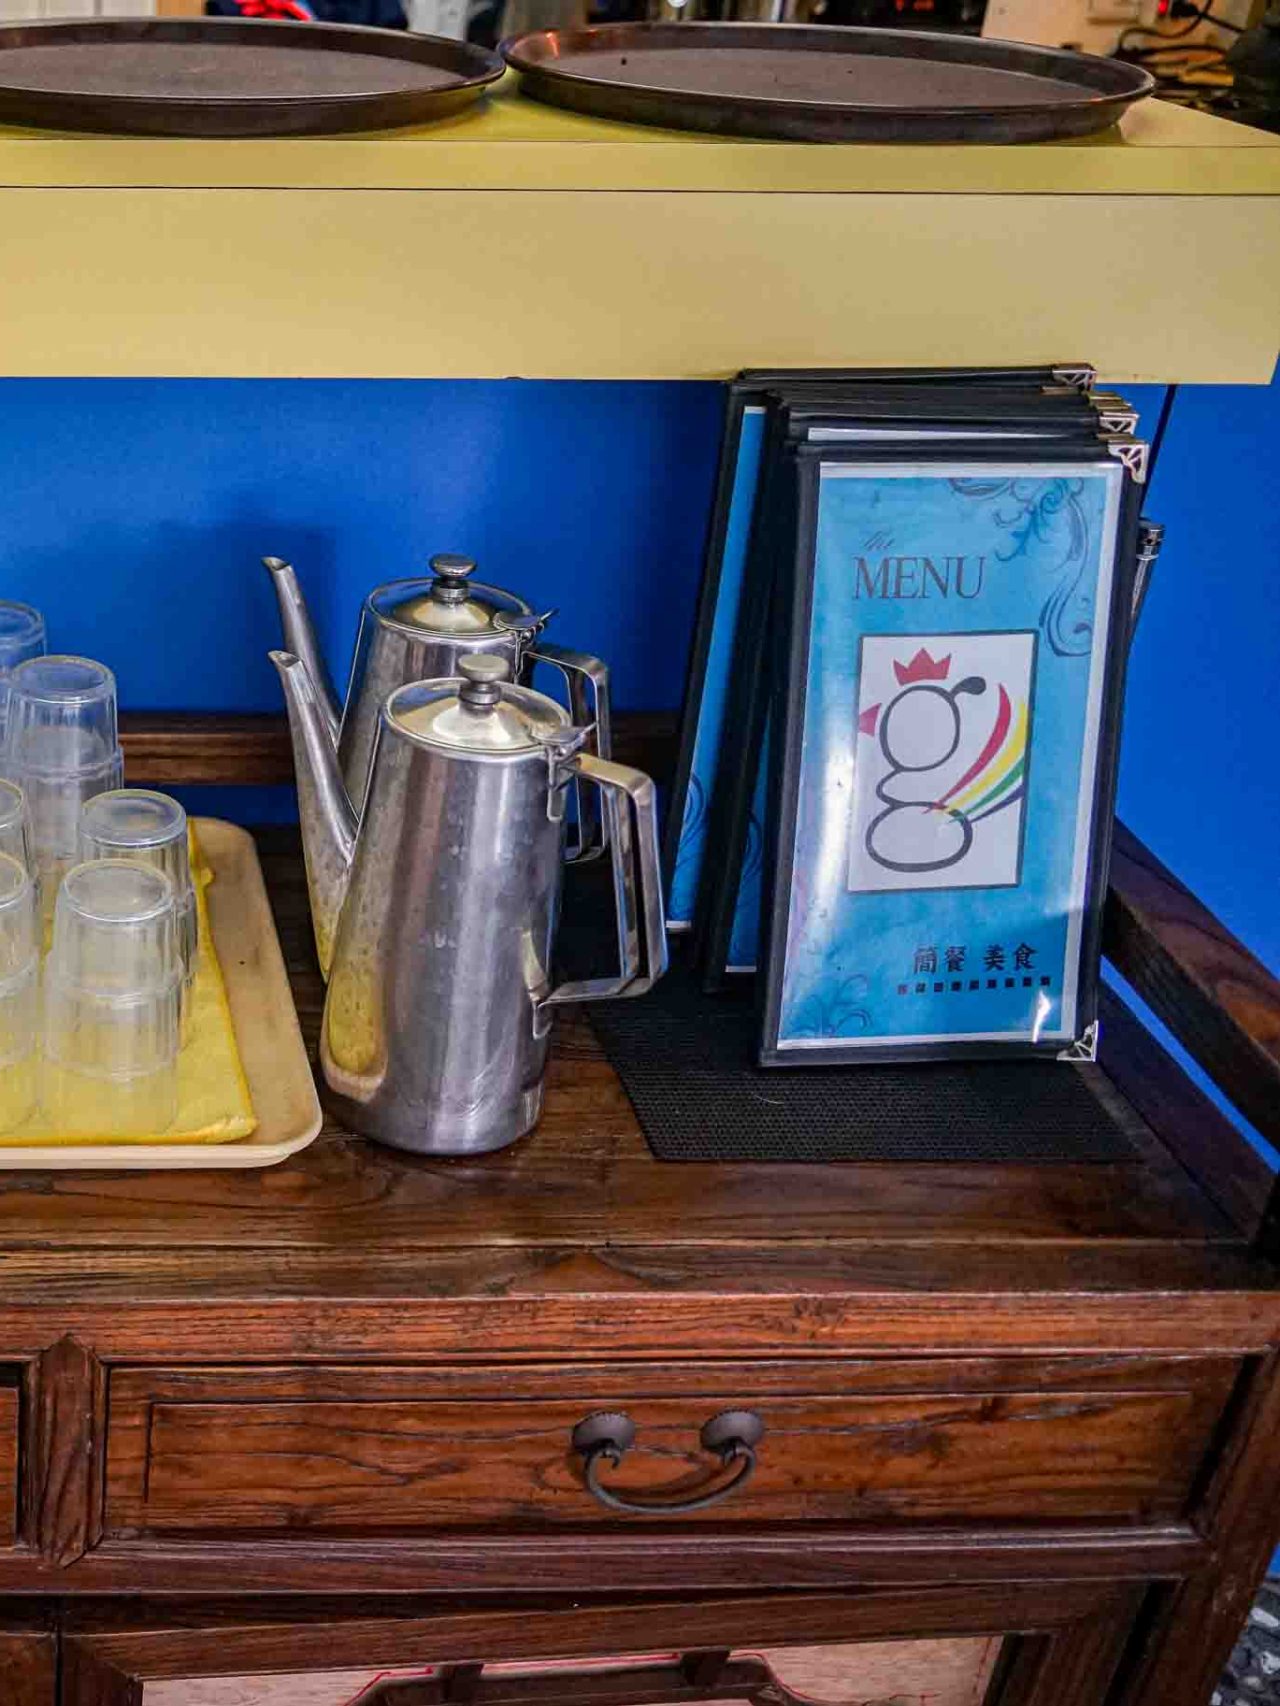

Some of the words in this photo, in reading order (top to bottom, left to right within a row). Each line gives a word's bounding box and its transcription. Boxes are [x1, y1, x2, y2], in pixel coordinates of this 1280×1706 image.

[853, 556, 986, 599] MENU
[914, 944, 966, 973] 簡餐
[983, 943, 1036, 971] 美食
